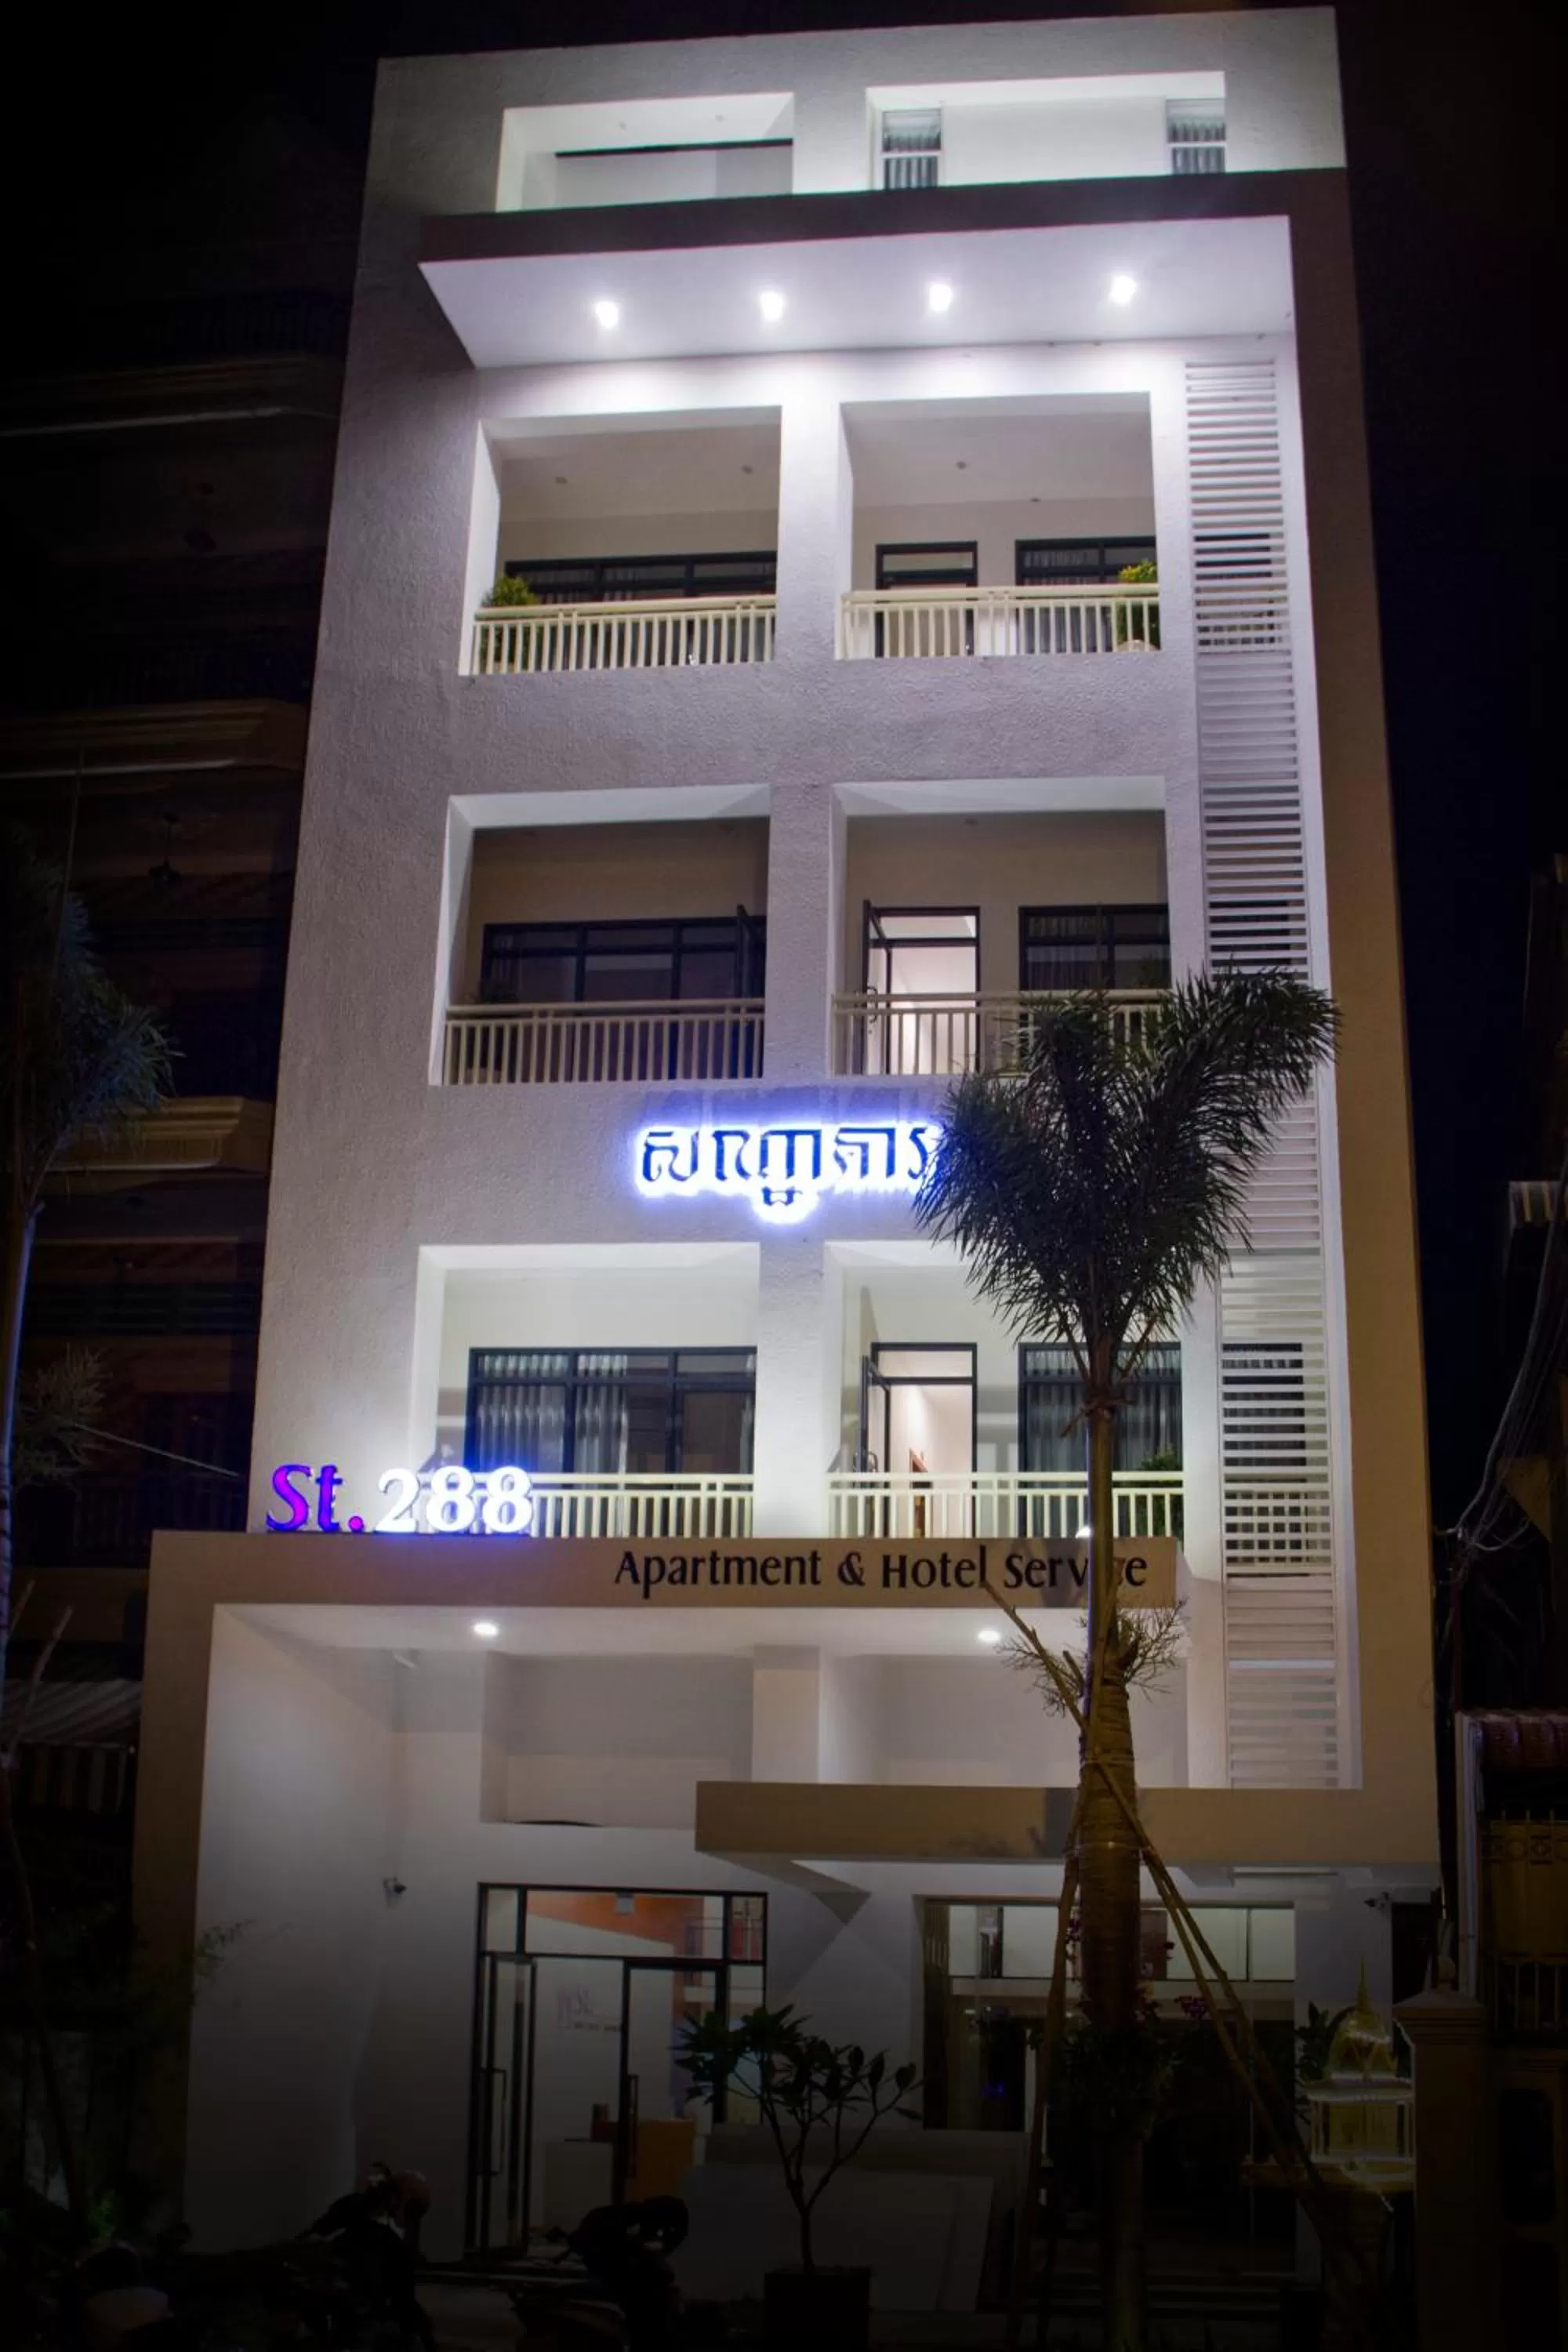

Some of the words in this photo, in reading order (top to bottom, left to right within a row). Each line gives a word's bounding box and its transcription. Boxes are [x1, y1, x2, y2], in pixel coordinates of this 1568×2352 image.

[266, 1463, 366, 1532] St.
[376, 1466, 534, 1533] 288
[614, 1550, 822, 1599] Apartment
[837, 1552, 866, 1586] &
[882, 1546, 986, 1588] Hotel
[1004, 1554, 1147, 1588] Serve
